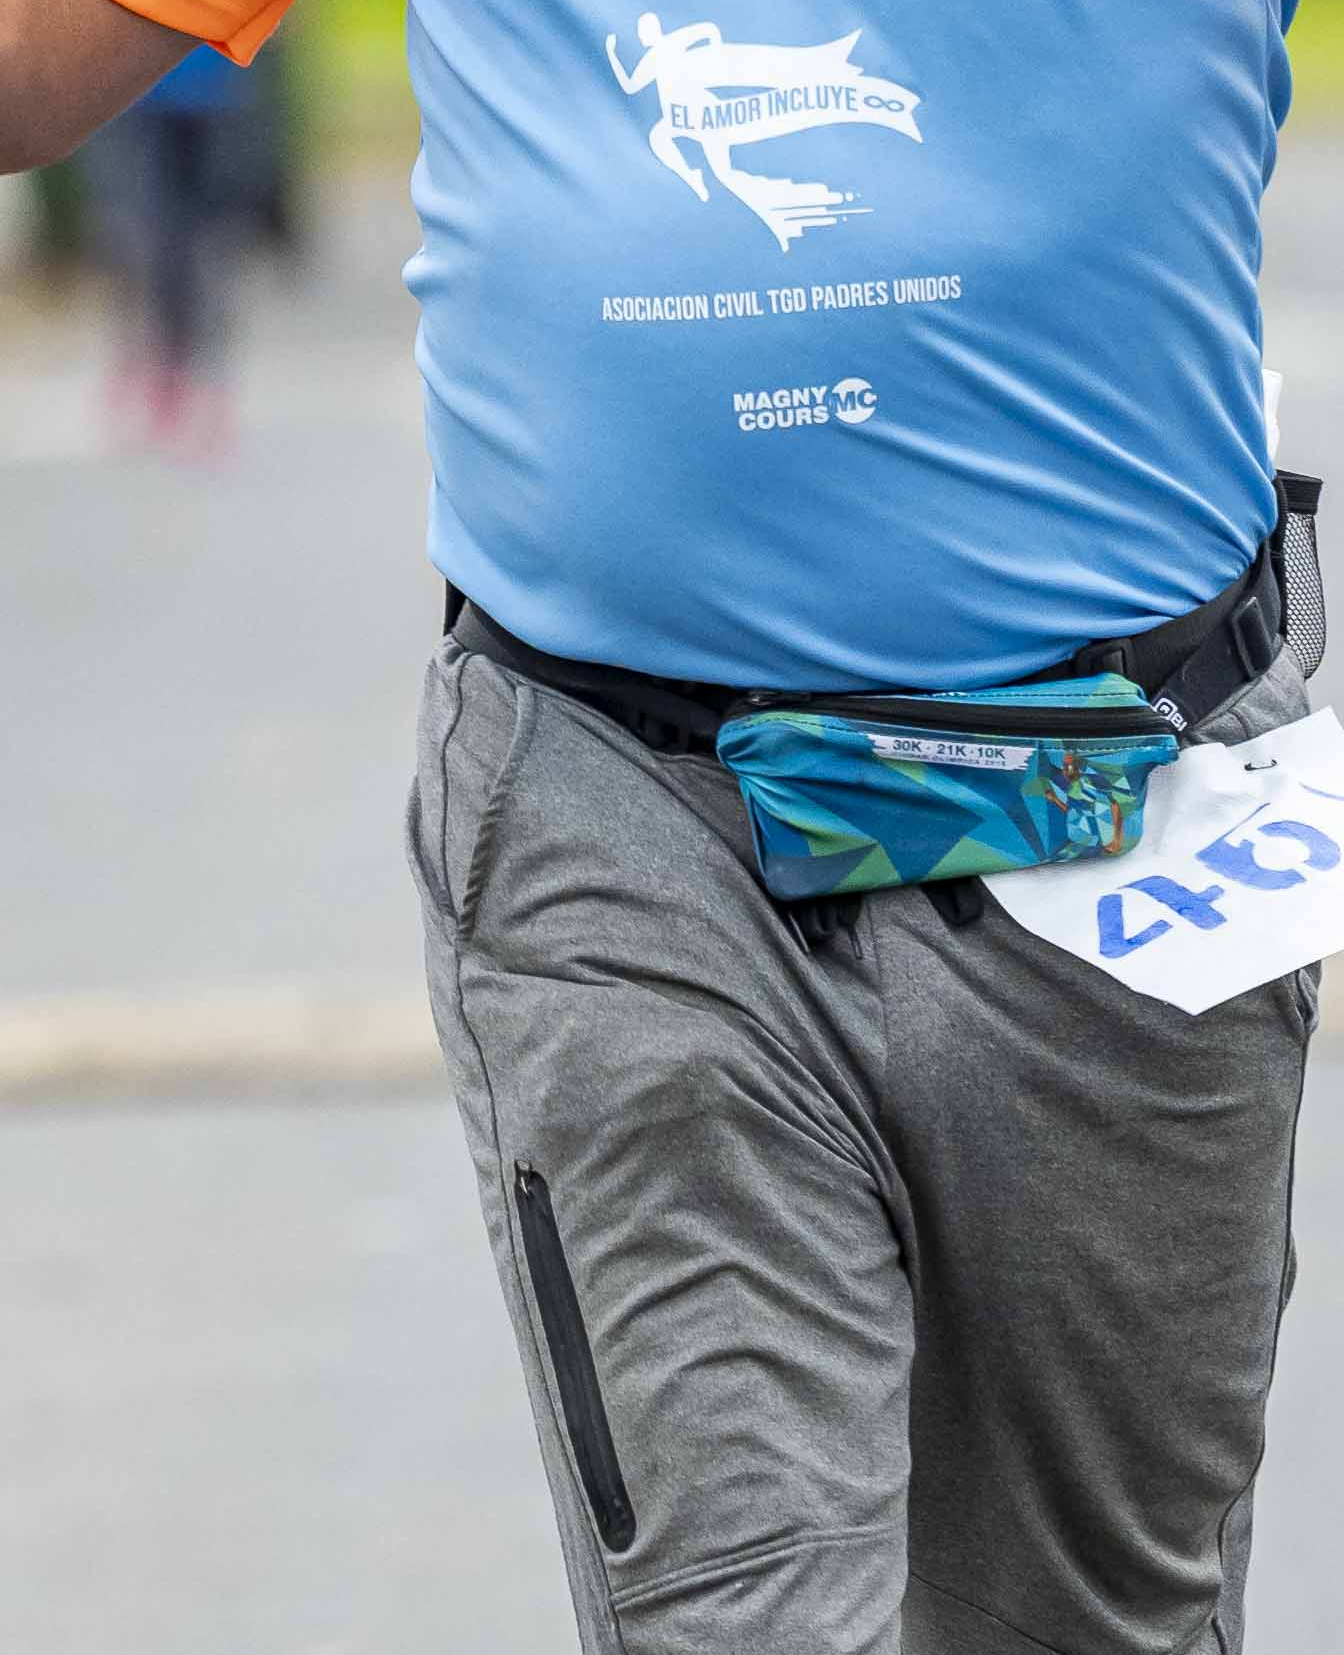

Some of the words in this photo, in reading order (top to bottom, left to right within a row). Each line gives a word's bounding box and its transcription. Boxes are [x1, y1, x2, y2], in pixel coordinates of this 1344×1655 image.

[670, 103, 695, 130] EL
[701, 96, 761, 131] AMOR
[768, 84, 859, 118] INCLUYE
[601, 295, 709, 323] ASOCIACION
[713, 291, 764, 320] CIVIL
[766, 288, 807, 314] TGD
[811, 281, 889, 311] PADRES
[893, 275, 962, 304] UNIDOS
[733, 385, 829, 413] MAGNY
[830, 383, 877, 417] MC
[738, 405, 830, 432] COURS
[892, 739, 922, 753] 30K
[937, 743, 968, 758] 21K
[978, 747, 1007, 760] 10K
